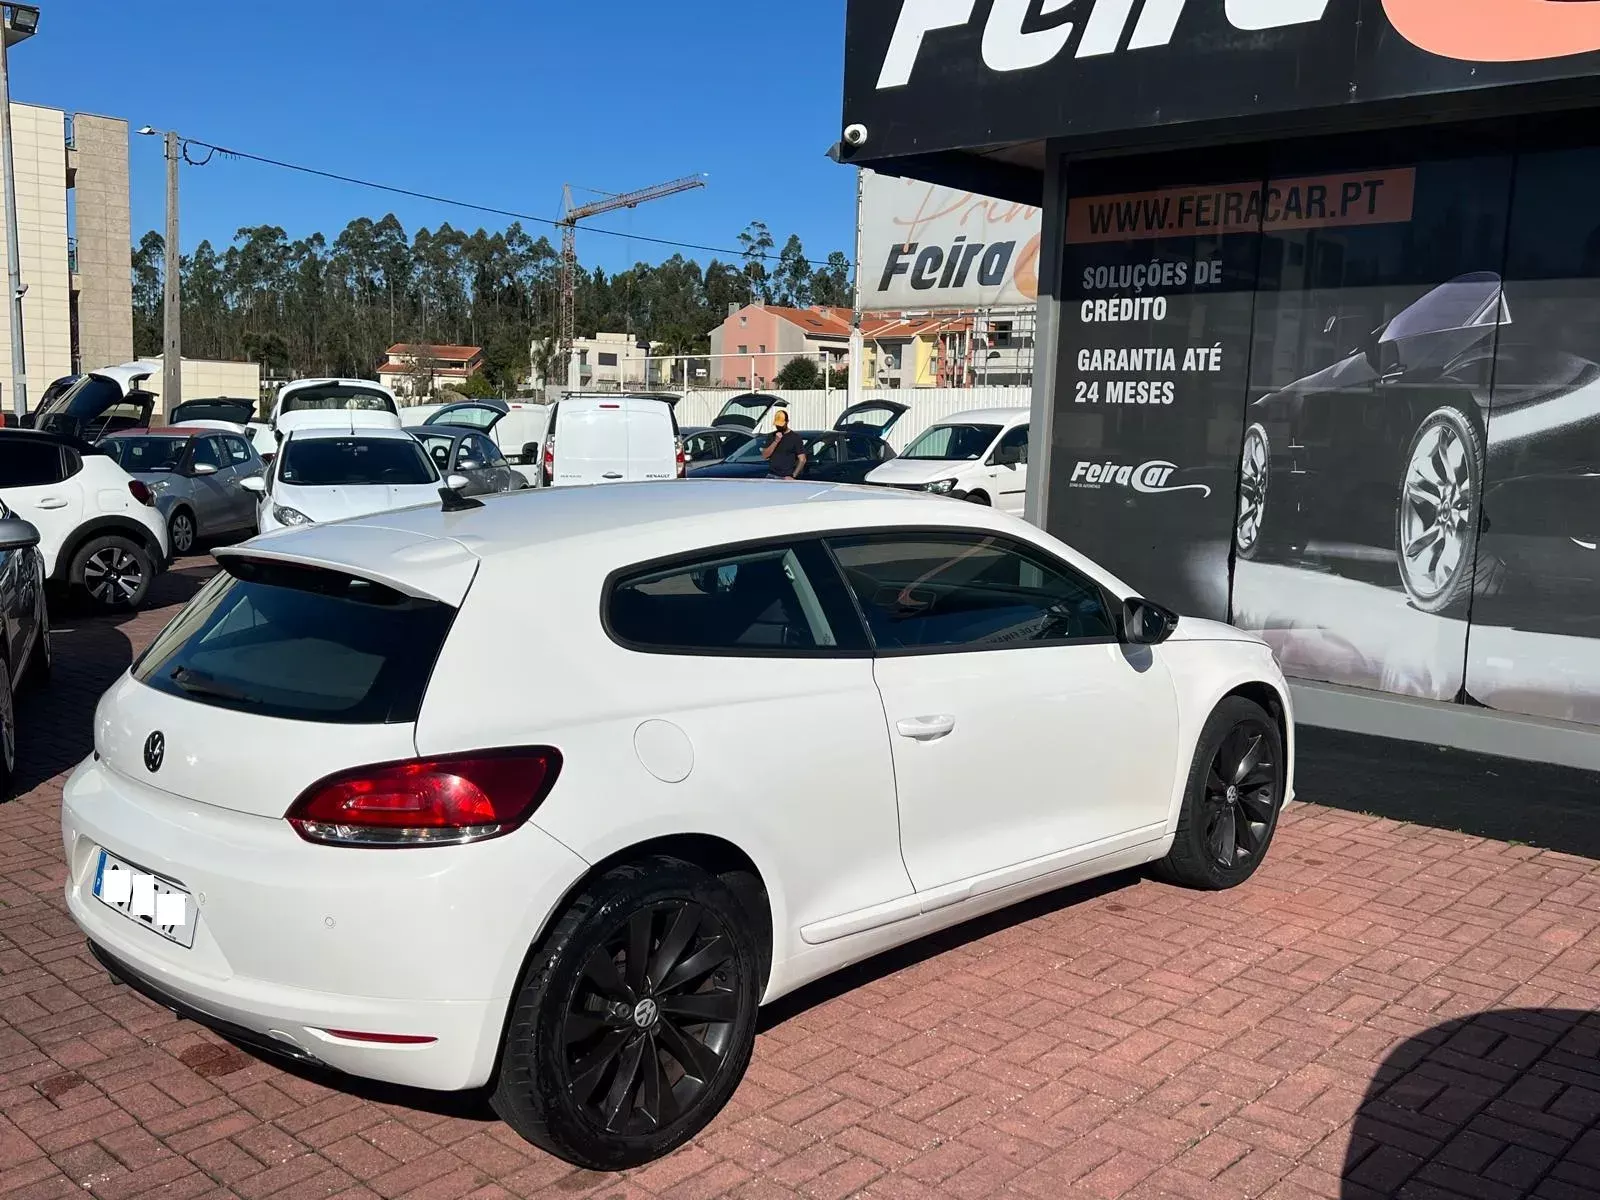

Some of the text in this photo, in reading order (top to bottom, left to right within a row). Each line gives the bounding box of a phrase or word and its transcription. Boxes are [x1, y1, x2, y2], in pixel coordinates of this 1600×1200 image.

[1088, 179, 1385, 234] WWW.FEIRACAR.PT
[1082, 259, 1223, 293] SOLUÇÕES DE
[1080, 293, 1167, 323] CRÉDITO
[1077, 342, 1222, 371] GARANTIA ATÉ
[1075, 381, 1175, 405] 24 MESES
[1070, 460, 1180, 493] FeiraCar
